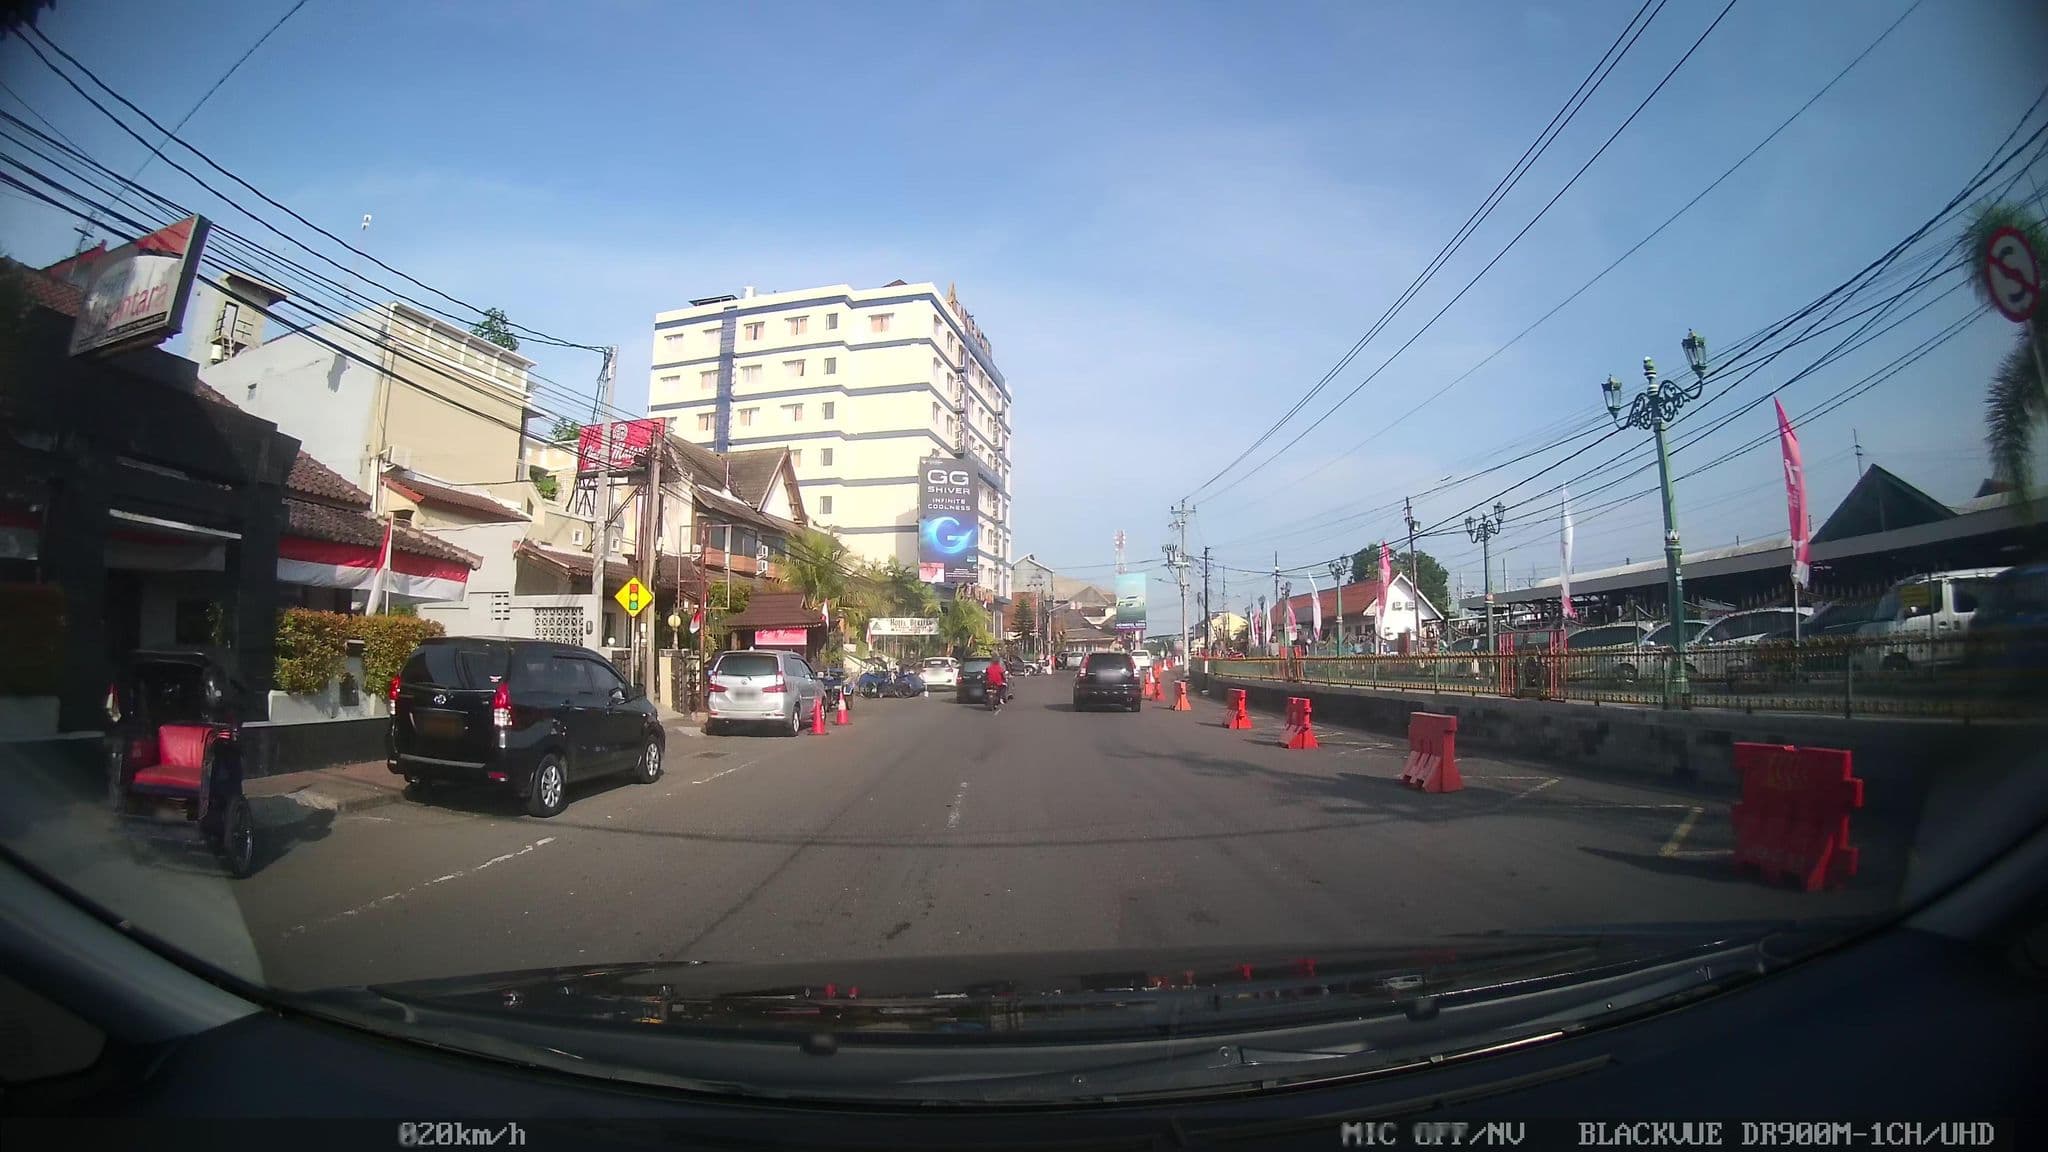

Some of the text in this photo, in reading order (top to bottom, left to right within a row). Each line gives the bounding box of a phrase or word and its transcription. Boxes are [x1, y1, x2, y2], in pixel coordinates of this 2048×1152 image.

[927, 469, 969, 486] GG
[927, 485, 970, 495] SHIVER
[932, 497, 966, 505] INFINITE
[927, 503, 971, 511] COOLNESS
